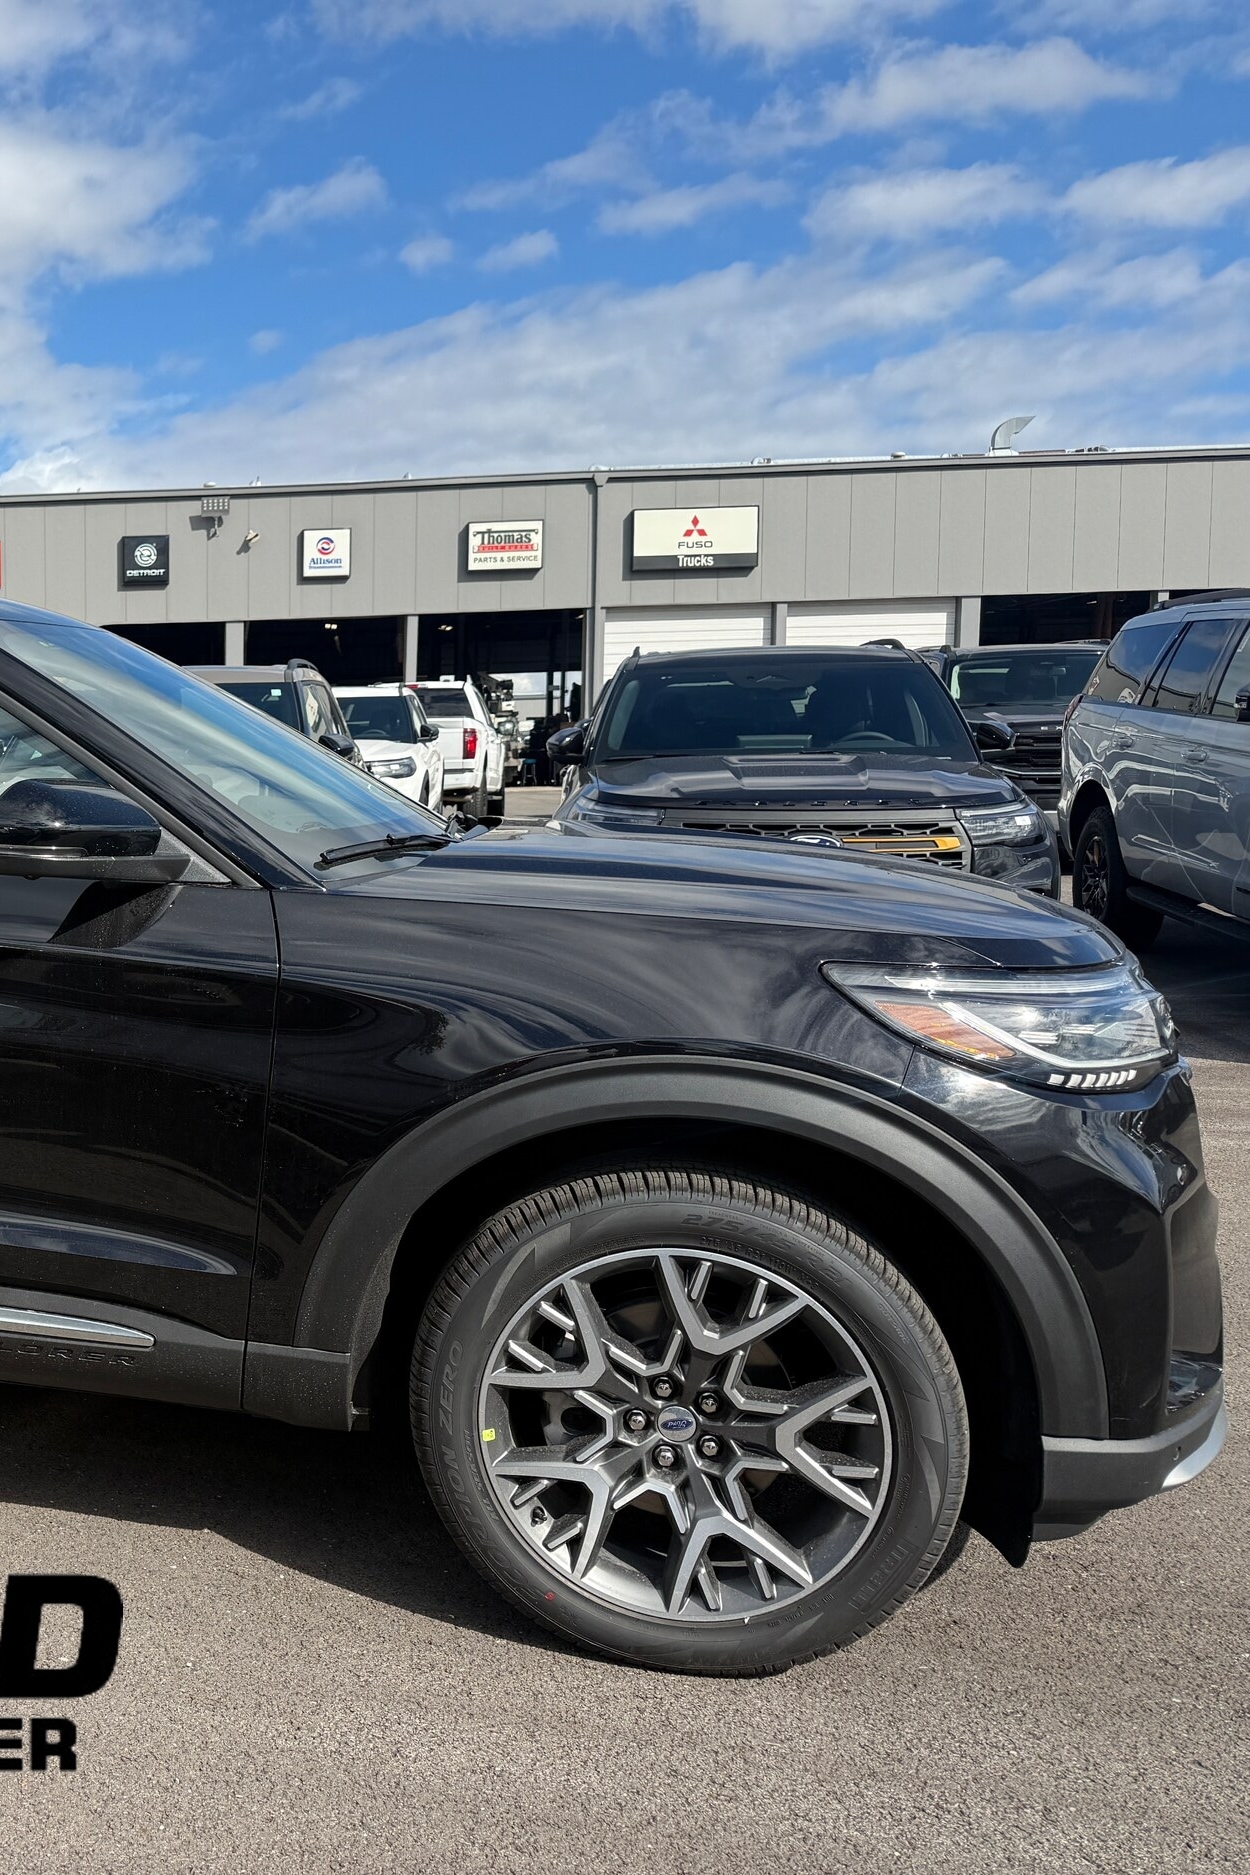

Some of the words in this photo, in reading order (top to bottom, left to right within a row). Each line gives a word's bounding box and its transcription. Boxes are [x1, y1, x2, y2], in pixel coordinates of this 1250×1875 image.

[476, 529, 534, 545] Thomas
[678, 541, 713, 549] FUSO
[309, 557, 342, 566] Allison
[507, 555, 538, 563] SERVICE
[677, 554, 714, 567] Trucks
[126, 569, 166, 577] DETROIT
[681, 1212, 797, 1253] 275/45
[438, 1338, 465, 1436] ZERO
